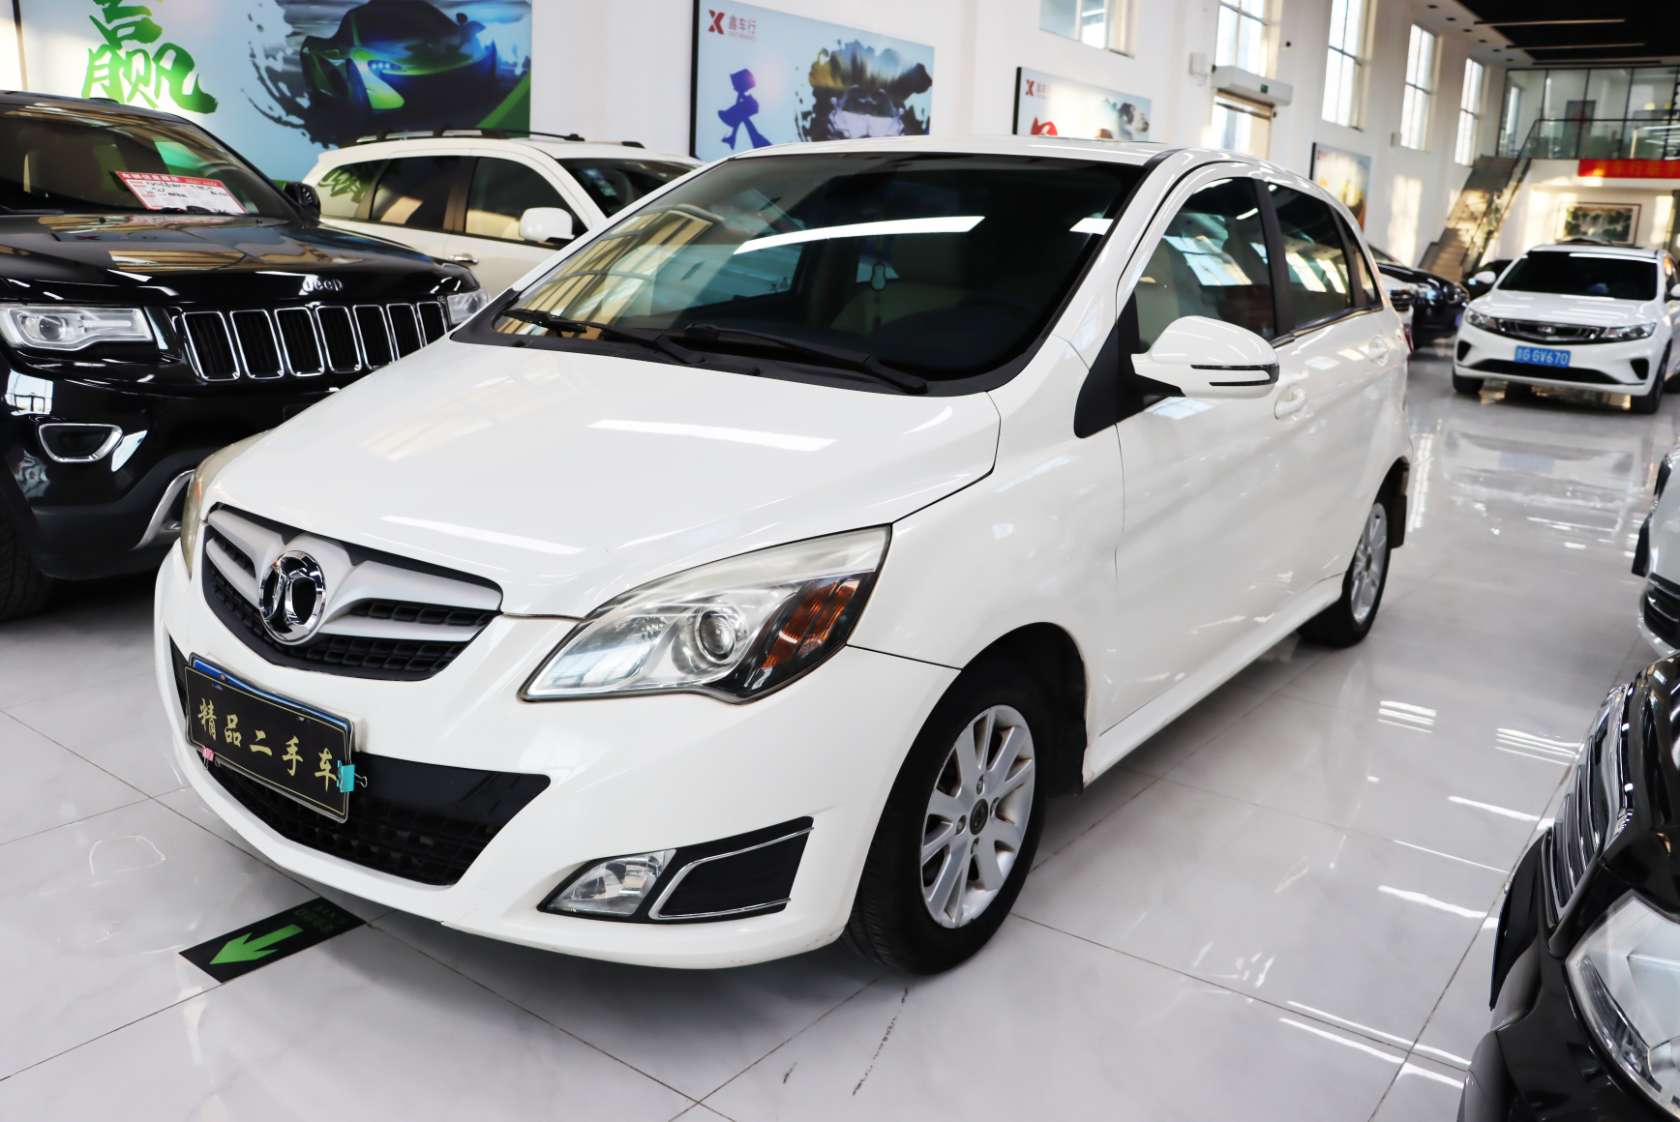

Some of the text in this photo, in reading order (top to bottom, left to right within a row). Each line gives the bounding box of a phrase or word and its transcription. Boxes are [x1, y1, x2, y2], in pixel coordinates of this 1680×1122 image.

[198, 698, 338, 793] 精品二手车
